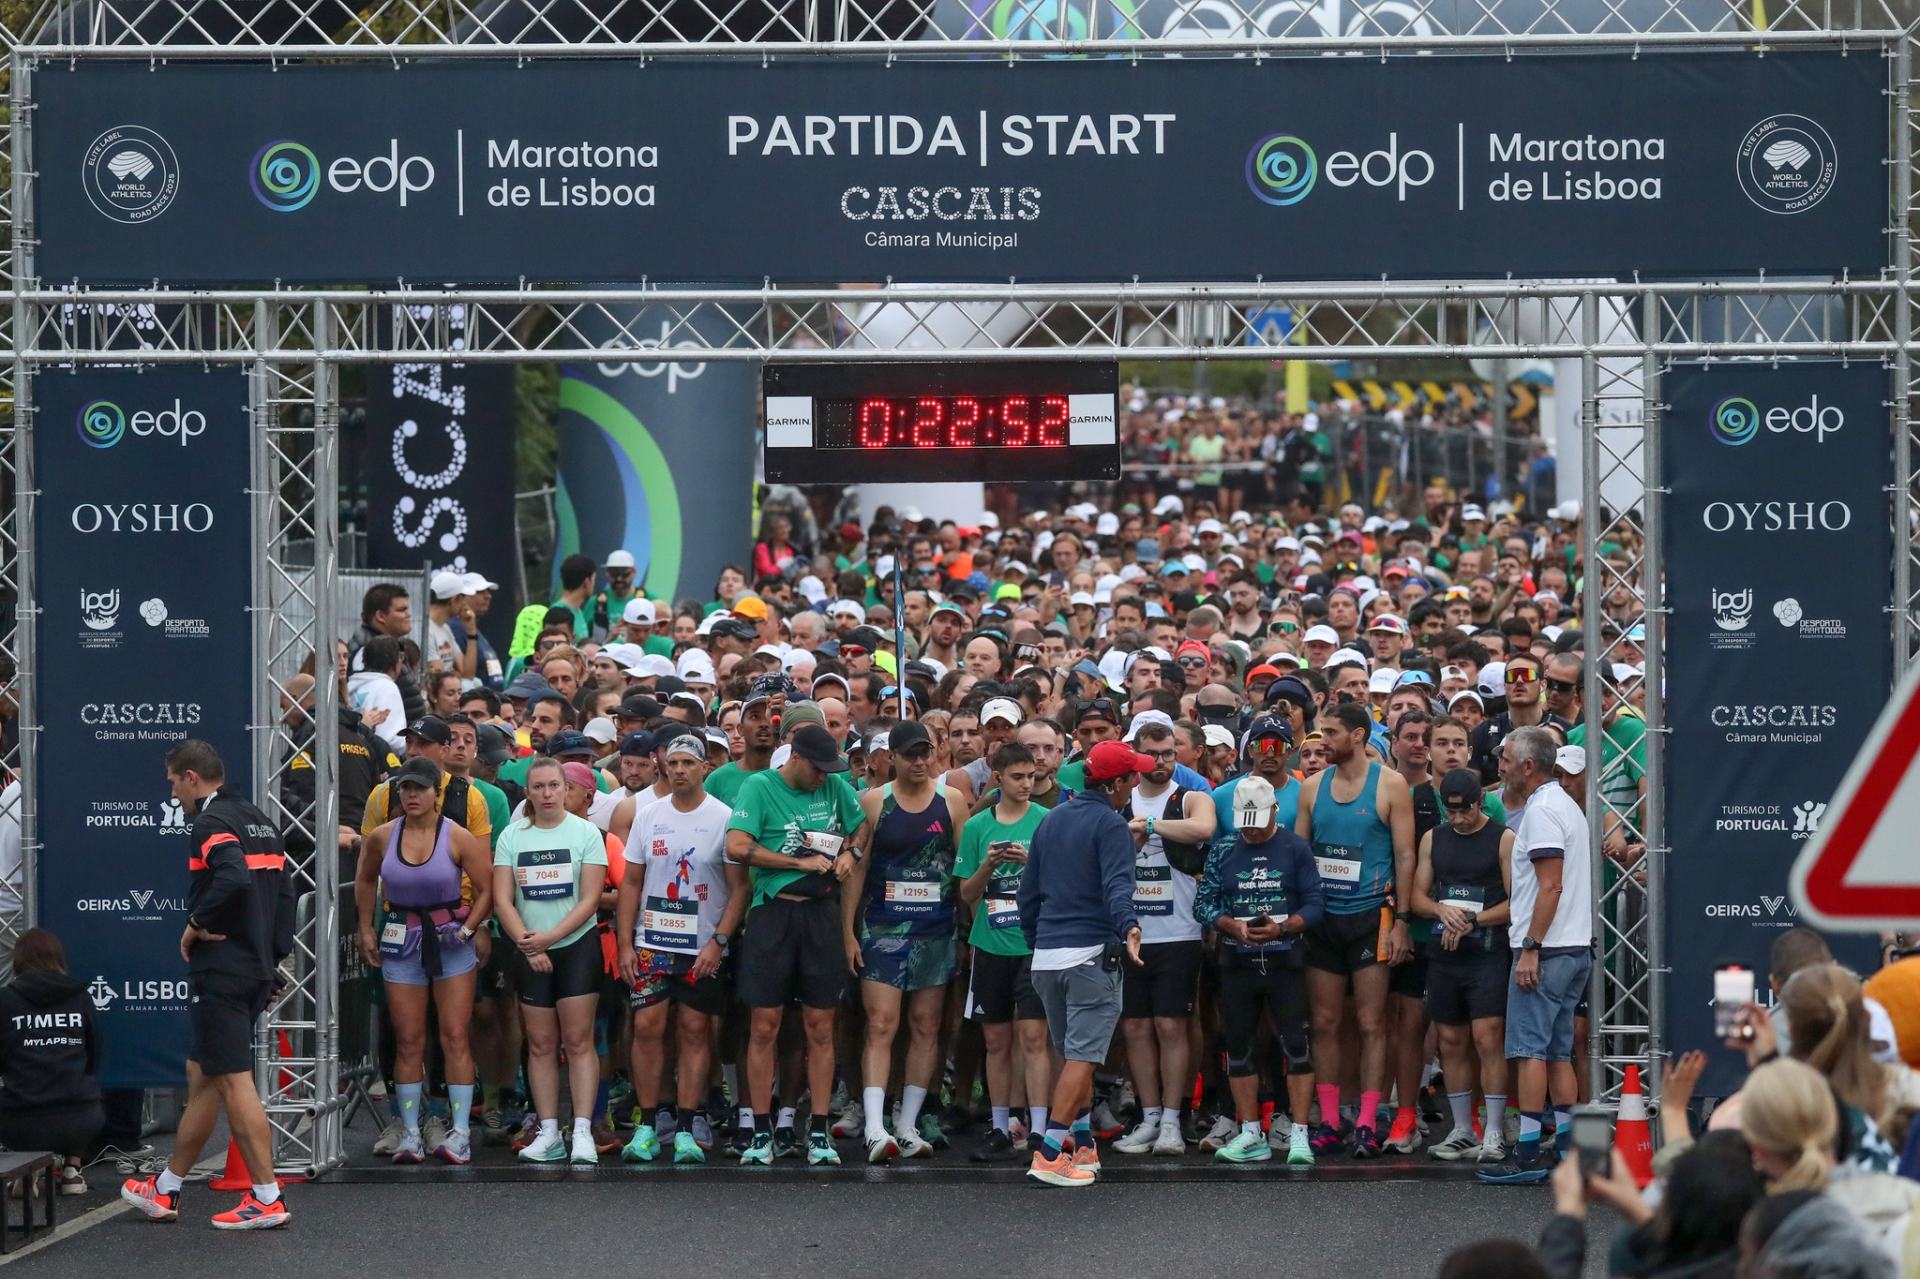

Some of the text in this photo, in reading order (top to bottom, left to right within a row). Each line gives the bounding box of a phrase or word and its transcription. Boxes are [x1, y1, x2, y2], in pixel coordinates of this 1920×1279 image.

[729, 115, 966, 155] PARTIDA
[1002, 114, 1175, 155] START
[1743, 121, 1778, 156] ELITE LABEL
[88, 132, 122, 166] ELITE LABEL
[1490, 133, 1664, 161] Maratona
[489, 140, 657, 167] Maratona
[328, 139, 434, 206] edp
[1326, 133, 1434, 201] edp
[488, 177, 654, 206] de Lisboa
[1489, 171, 1660, 201] de Lisboa
[1786, 162, 1832, 210] ROAD RACE 2025
[130, 174, 174, 218] ROAD RACE 2025
[841, 186, 1041, 220] CASCAIS
[865, 232, 1017, 250] Câmara Municipal
[131, 399, 206, 446] edp
[1766, 394, 1843, 442] edp
[72, 504, 213, 532] OYSHO
[1704, 501, 1850, 531] OYSHO
[80, 588, 120, 615] ipdj
[1712, 588, 1752, 616] ipdj
[80, 703, 201, 724] CASCAIS
[1711, 705, 1837, 726] CASCAIS
[95, 730, 187, 741] Câmara Municipal
[1726, 732, 1822, 744] Câmara Municipal
[92, 802, 148, 811] TURISMO DE
[1722, 806, 1780, 815] TURISMO DE
[86, 815, 156, 827] PORTUGAL
[1716, 820, 1789, 831] PORTUGAL
[652, 840, 664, 848] BCN
[541, 852, 556, 861] edp
[652, 848, 668, 856] RUNS
[1334, 847, 1348, 856] edp
[535, 870, 559, 880] 7048
[911, 870, 926, 879] edp
[1144, 869, 1158, 878] edp
[1324, 864, 1350, 874] 12890
[538, 888, 566, 896] HYUNDAI
[903, 888, 928, 896] 12195
[1136, 887, 1162, 895] 10648
[1455, 888, 1469, 897] edp
[77, 899, 188, 910] OEIRAS VALL
[668, 902, 682, 910] edp
[1257, 904, 1272, 912] edp
[1705, 904, 1761, 916] OEIRAS
[660, 918, 686, 928] 12855
[125, 981, 188, 1000] LISBO
[24, 1038, 67, 1046] MYLAPS
